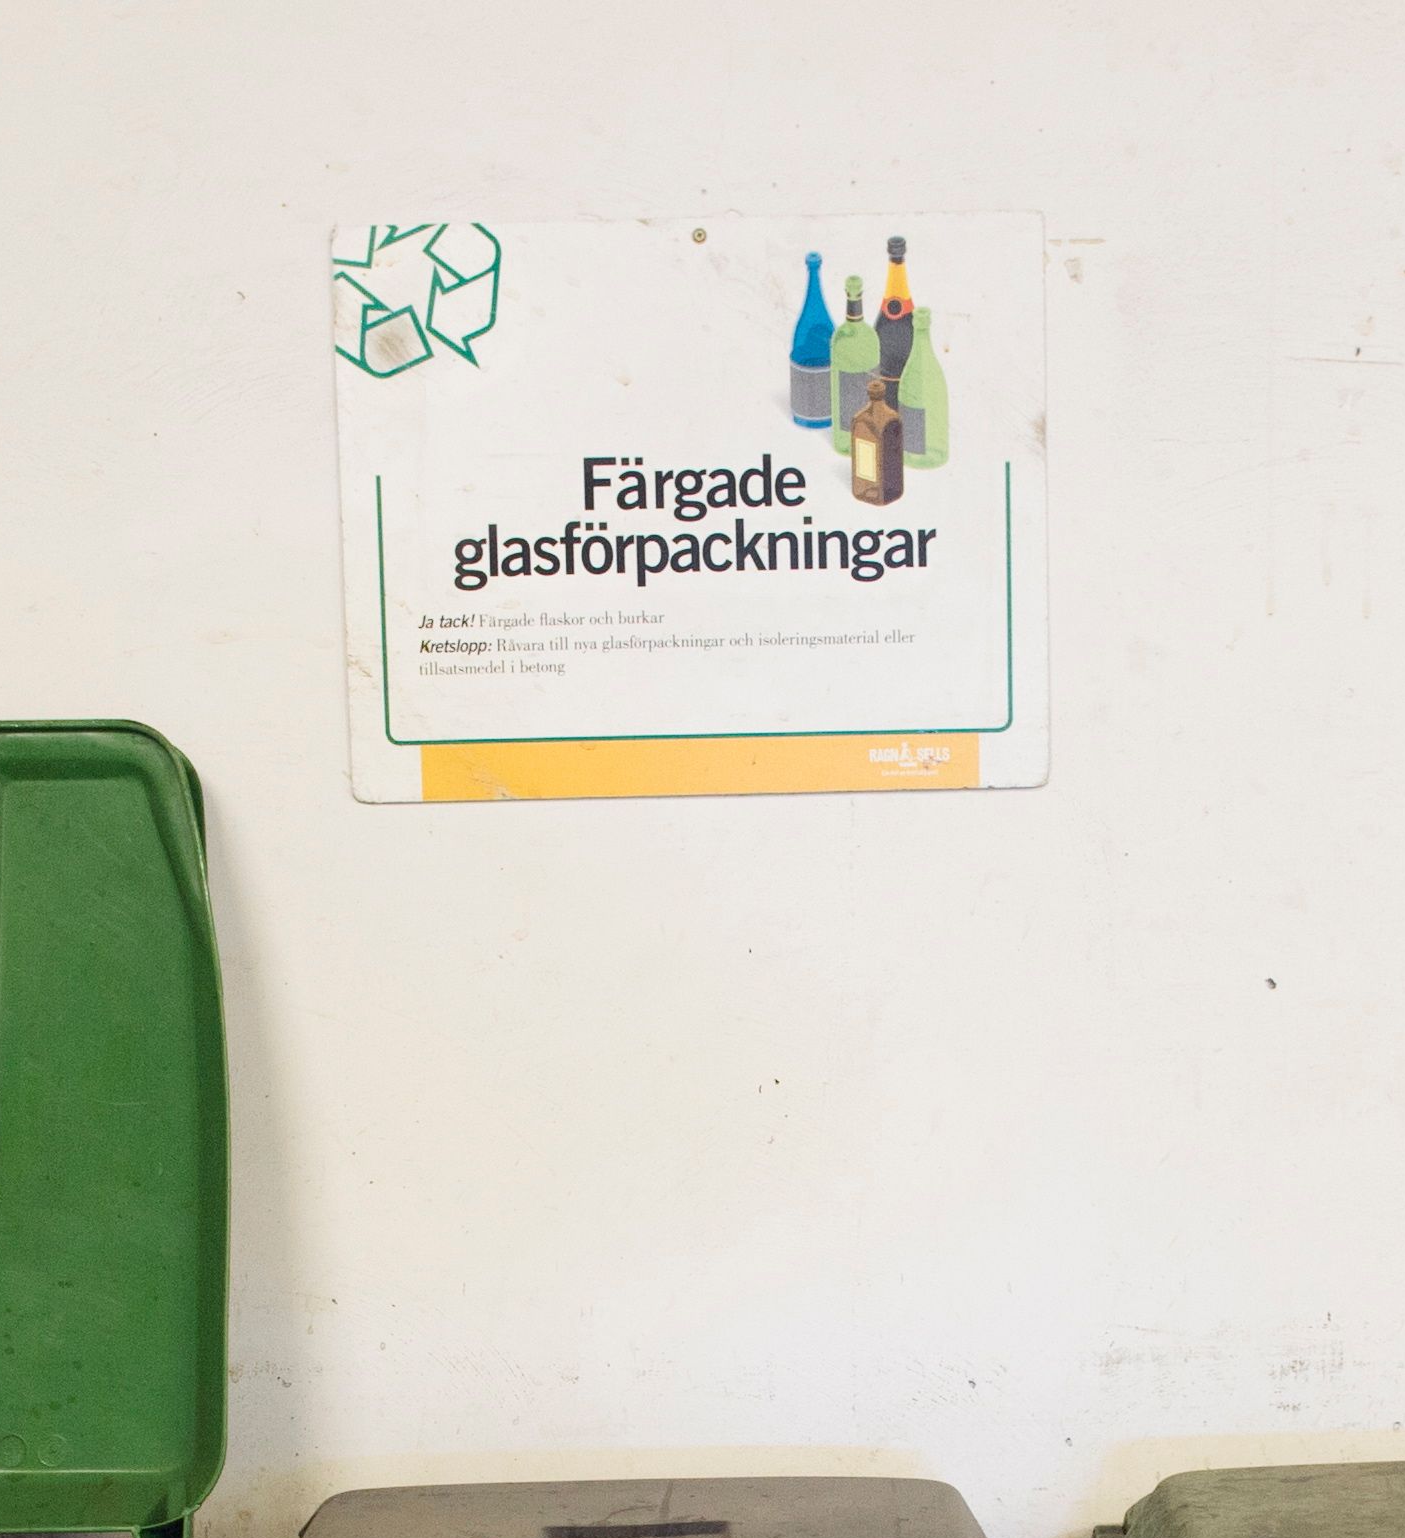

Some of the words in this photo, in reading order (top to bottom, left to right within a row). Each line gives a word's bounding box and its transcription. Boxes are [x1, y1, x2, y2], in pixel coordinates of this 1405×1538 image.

[583, 453, 806, 521] Färgade
[453, 516, 937, 591] glasförpackningar
[418, 614, 434, 629] Ja
[439, 613, 475, 629] tack!
[479, 613, 535, 630] Färgade
[539, 611, 586, 626] flaskor
[589, 610, 614, 625] och
[618, 610, 665, 624] burkar
[419, 639, 492, 655] Kretslopp:
[496, 636, 545, 652] Råvara
[549, 636, 569, 651] till
[574, 640, 598, 654] nya
[601, 635, 725, 653] glasförpackningar
[729, 632, 754, 647] och
[758, 630, 880, 648] isoleringsmaterial
[884, 629, 916, 645] eller
[419, 661, 506, 675] tillsatsmedel
[520, 660, 566, 675] betong
